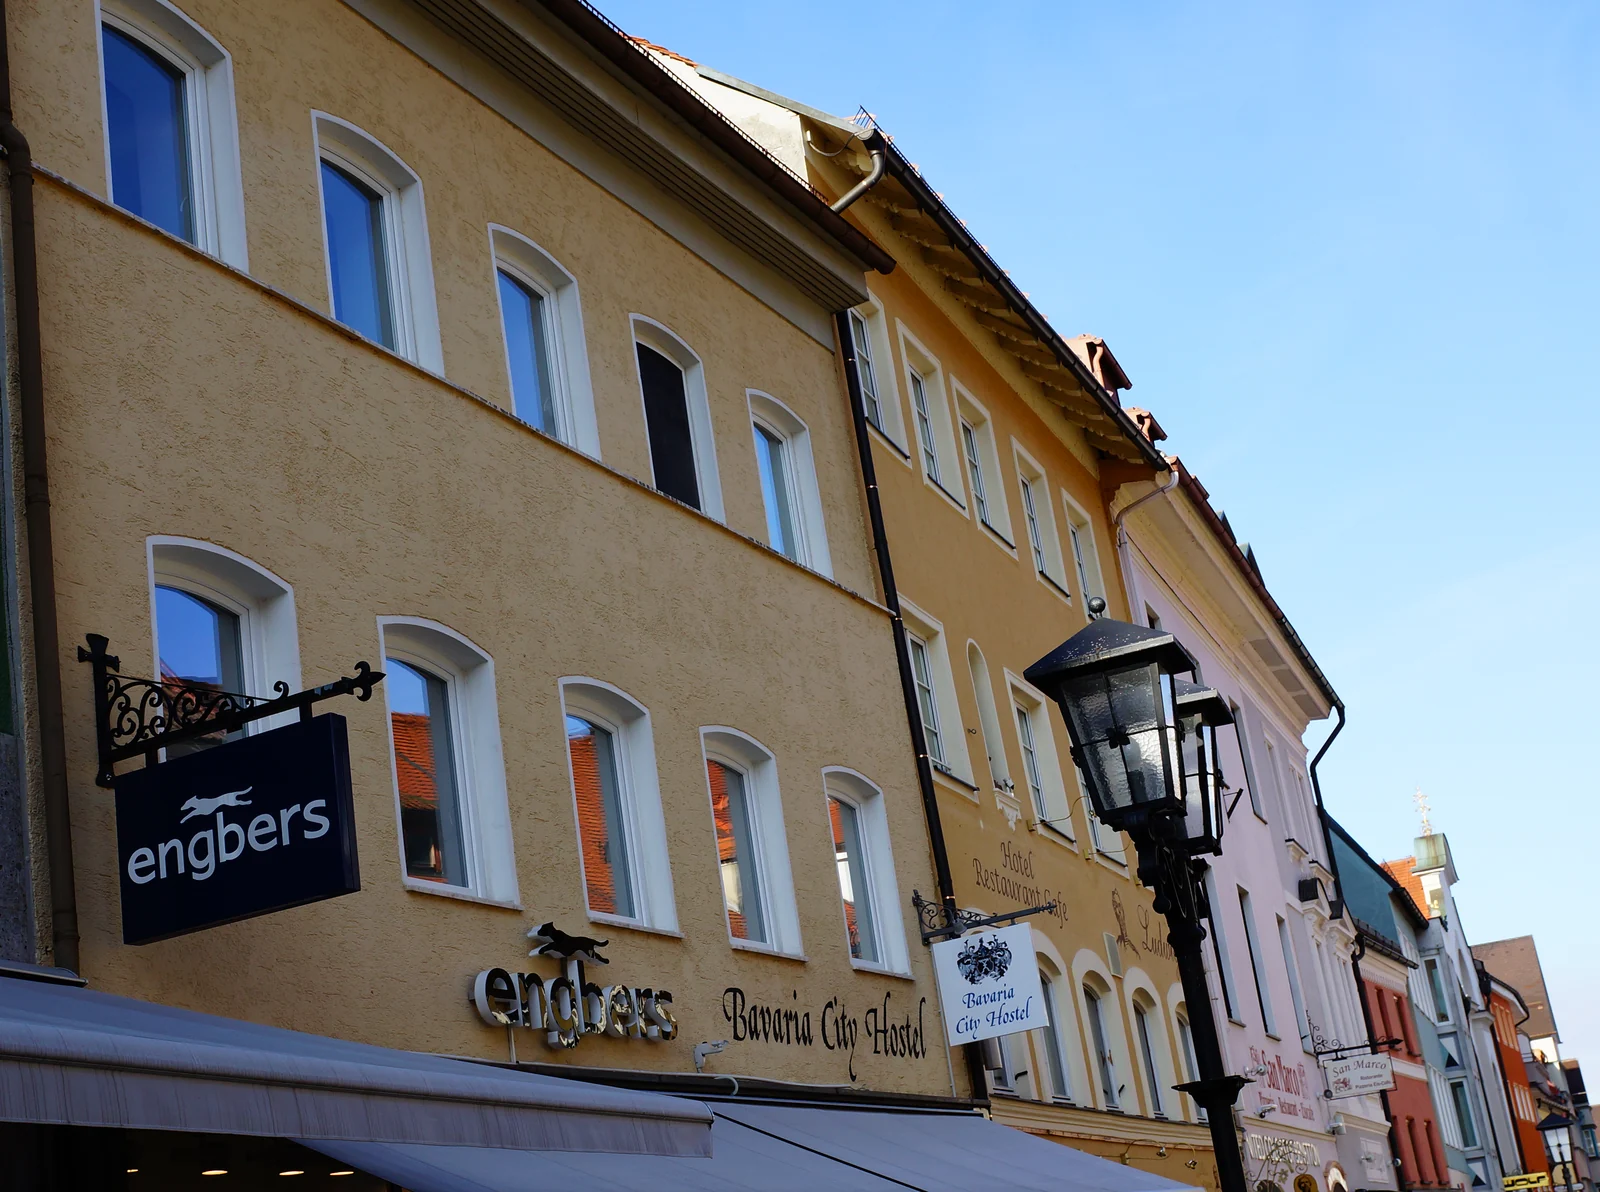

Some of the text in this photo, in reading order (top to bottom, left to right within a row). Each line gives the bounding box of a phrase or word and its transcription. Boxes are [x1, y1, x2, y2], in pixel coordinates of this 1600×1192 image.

[127, 799, 330, 884] engbers
[1001, 840, 1035, 879] Hotel
[972, 858, 1042, 907] Restaurant
[472, 959, 678, 1050] engbers
[956, 996, 1033, 1040] City Hostel
[962, 983, 1015, 1009] Bavaria
[723, 987, 927, 1082] Bavaria City Hostel
[1333, 1059, 1387, 1078] San Marco
[1504, 1175, 1546, 1188] WOLF
